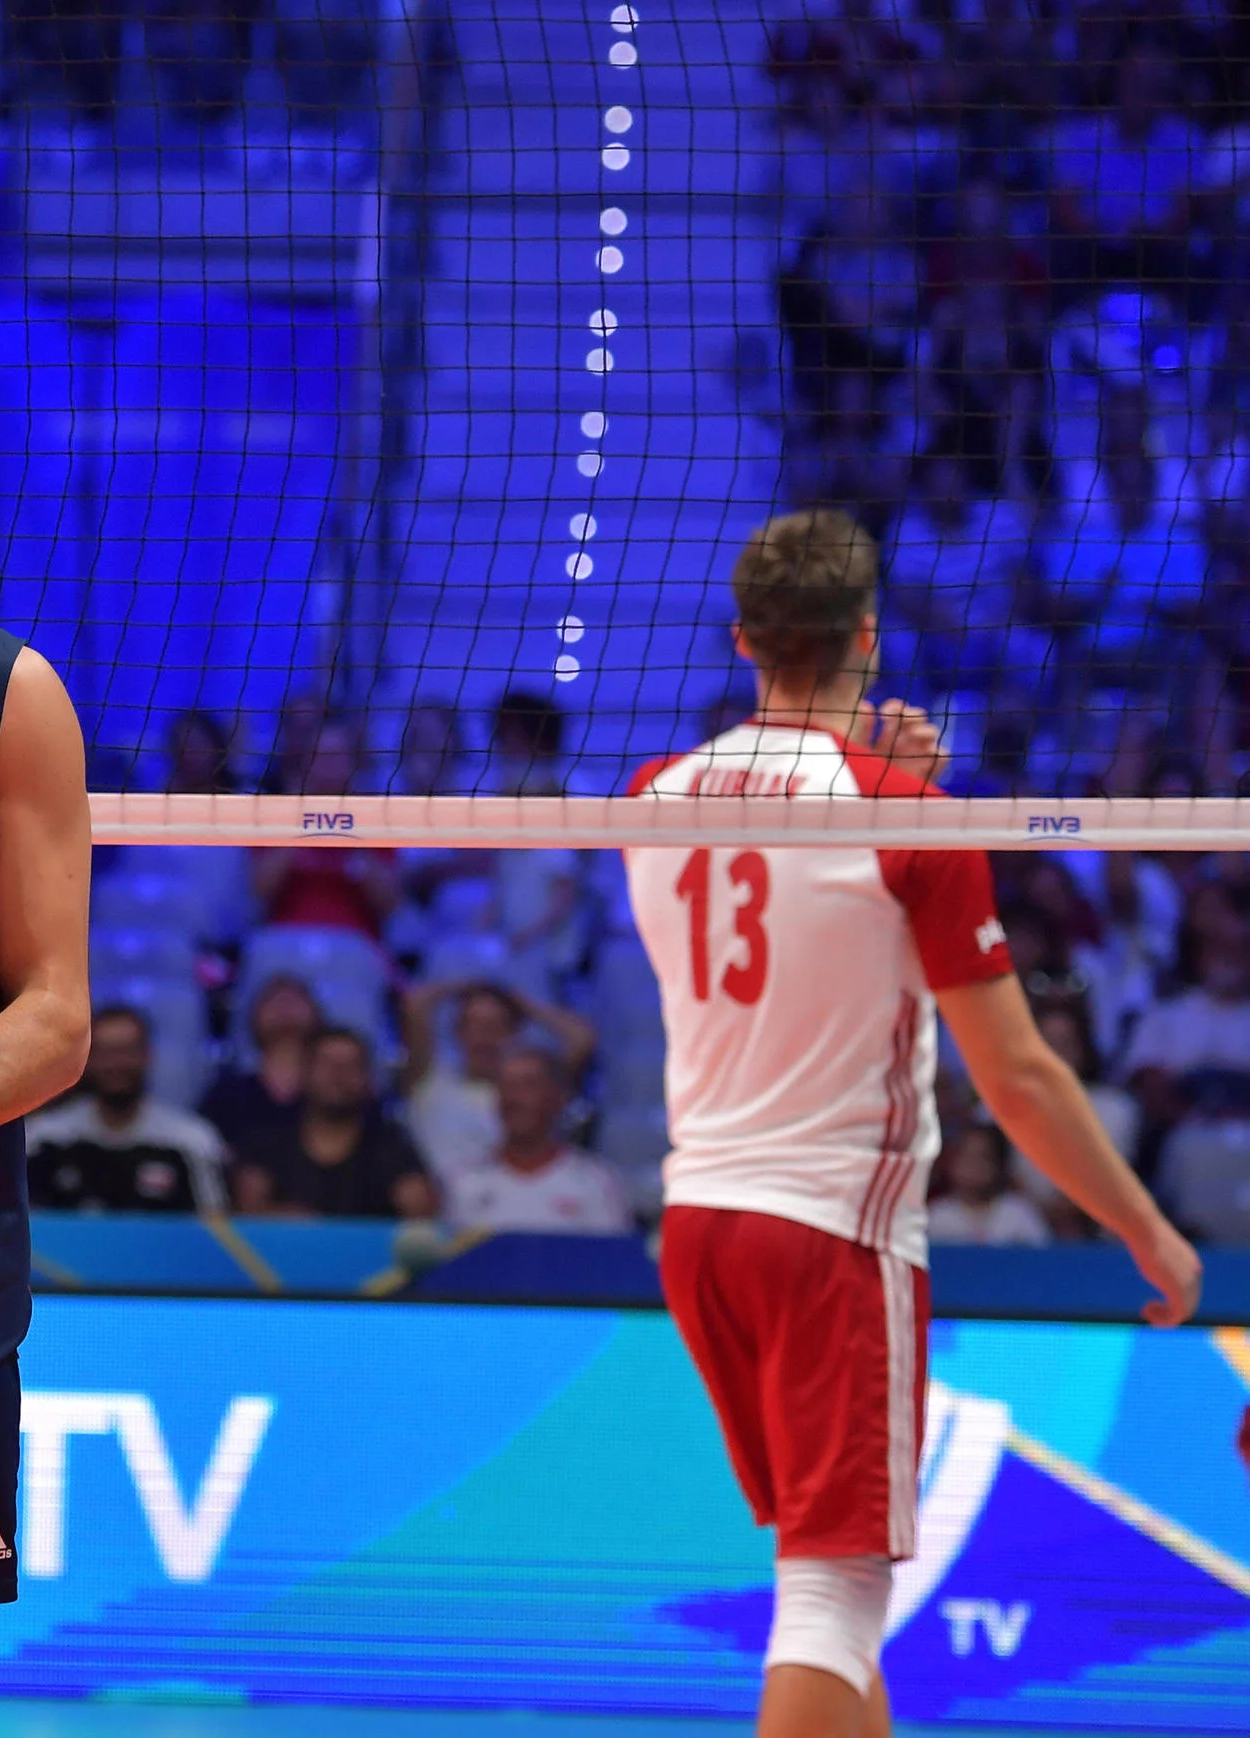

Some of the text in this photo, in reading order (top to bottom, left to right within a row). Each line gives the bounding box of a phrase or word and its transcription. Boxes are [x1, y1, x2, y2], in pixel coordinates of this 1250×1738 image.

[303, 813, 354, 830] FIVB
[1028, 816, 1081, 833] FIVB
[674, 848, 771, 1007] 13
[18, 1390, 275, 1583] TV
[939, 1598, 1031, 1658] TV
